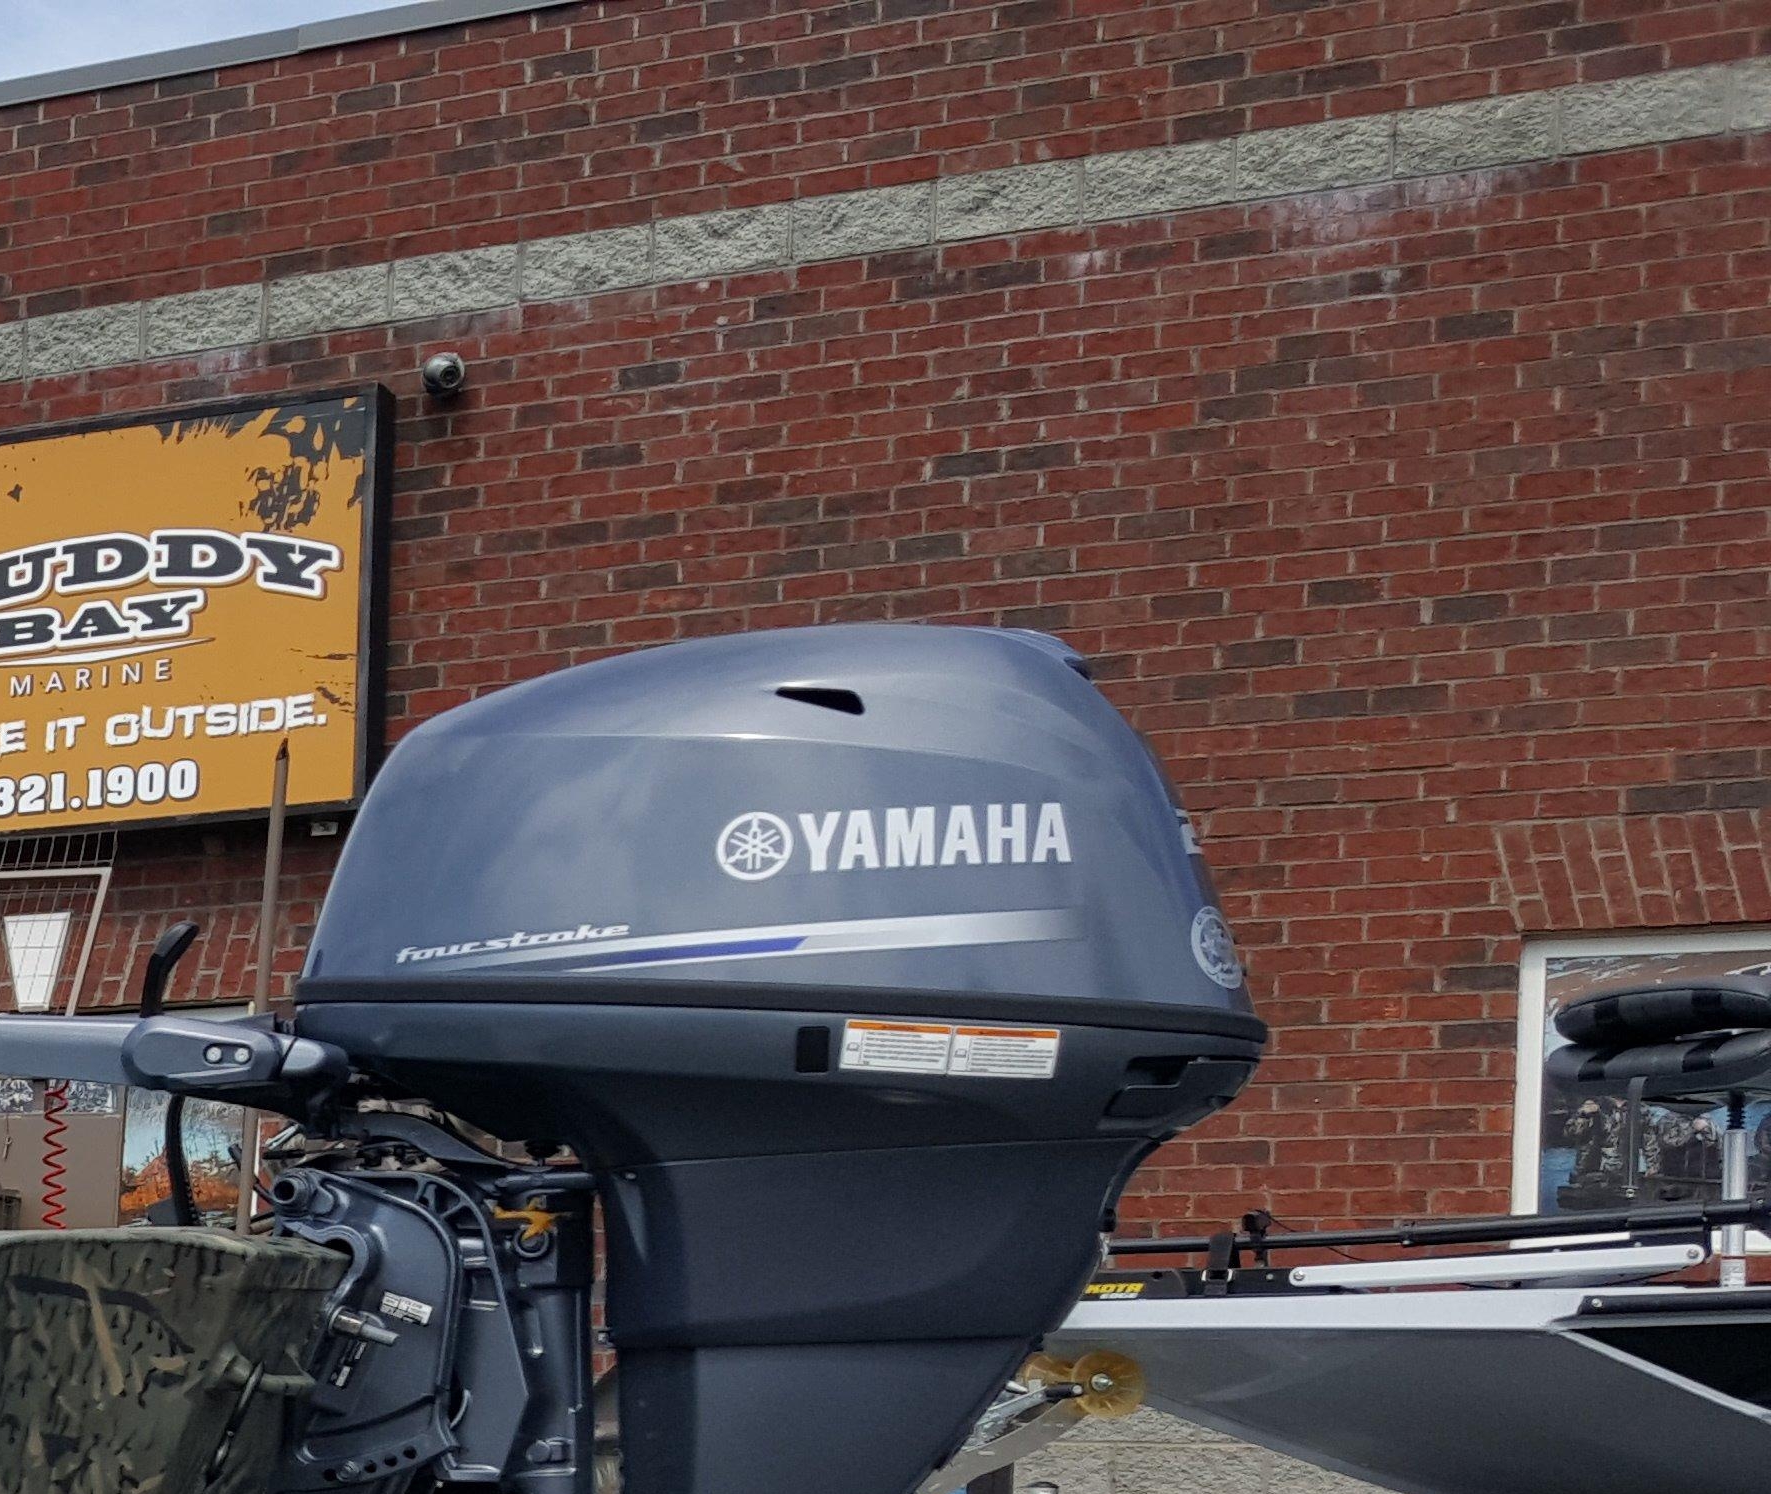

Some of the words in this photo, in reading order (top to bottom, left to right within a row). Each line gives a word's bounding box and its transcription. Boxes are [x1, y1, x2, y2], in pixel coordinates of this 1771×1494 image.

[10, 659, 173, 697] MARINE
[44, 715, 87, 752] IT
[105, 692, 328, 749] OUTSIDE.
[799, 803, 1073, 872] YAMAHA
